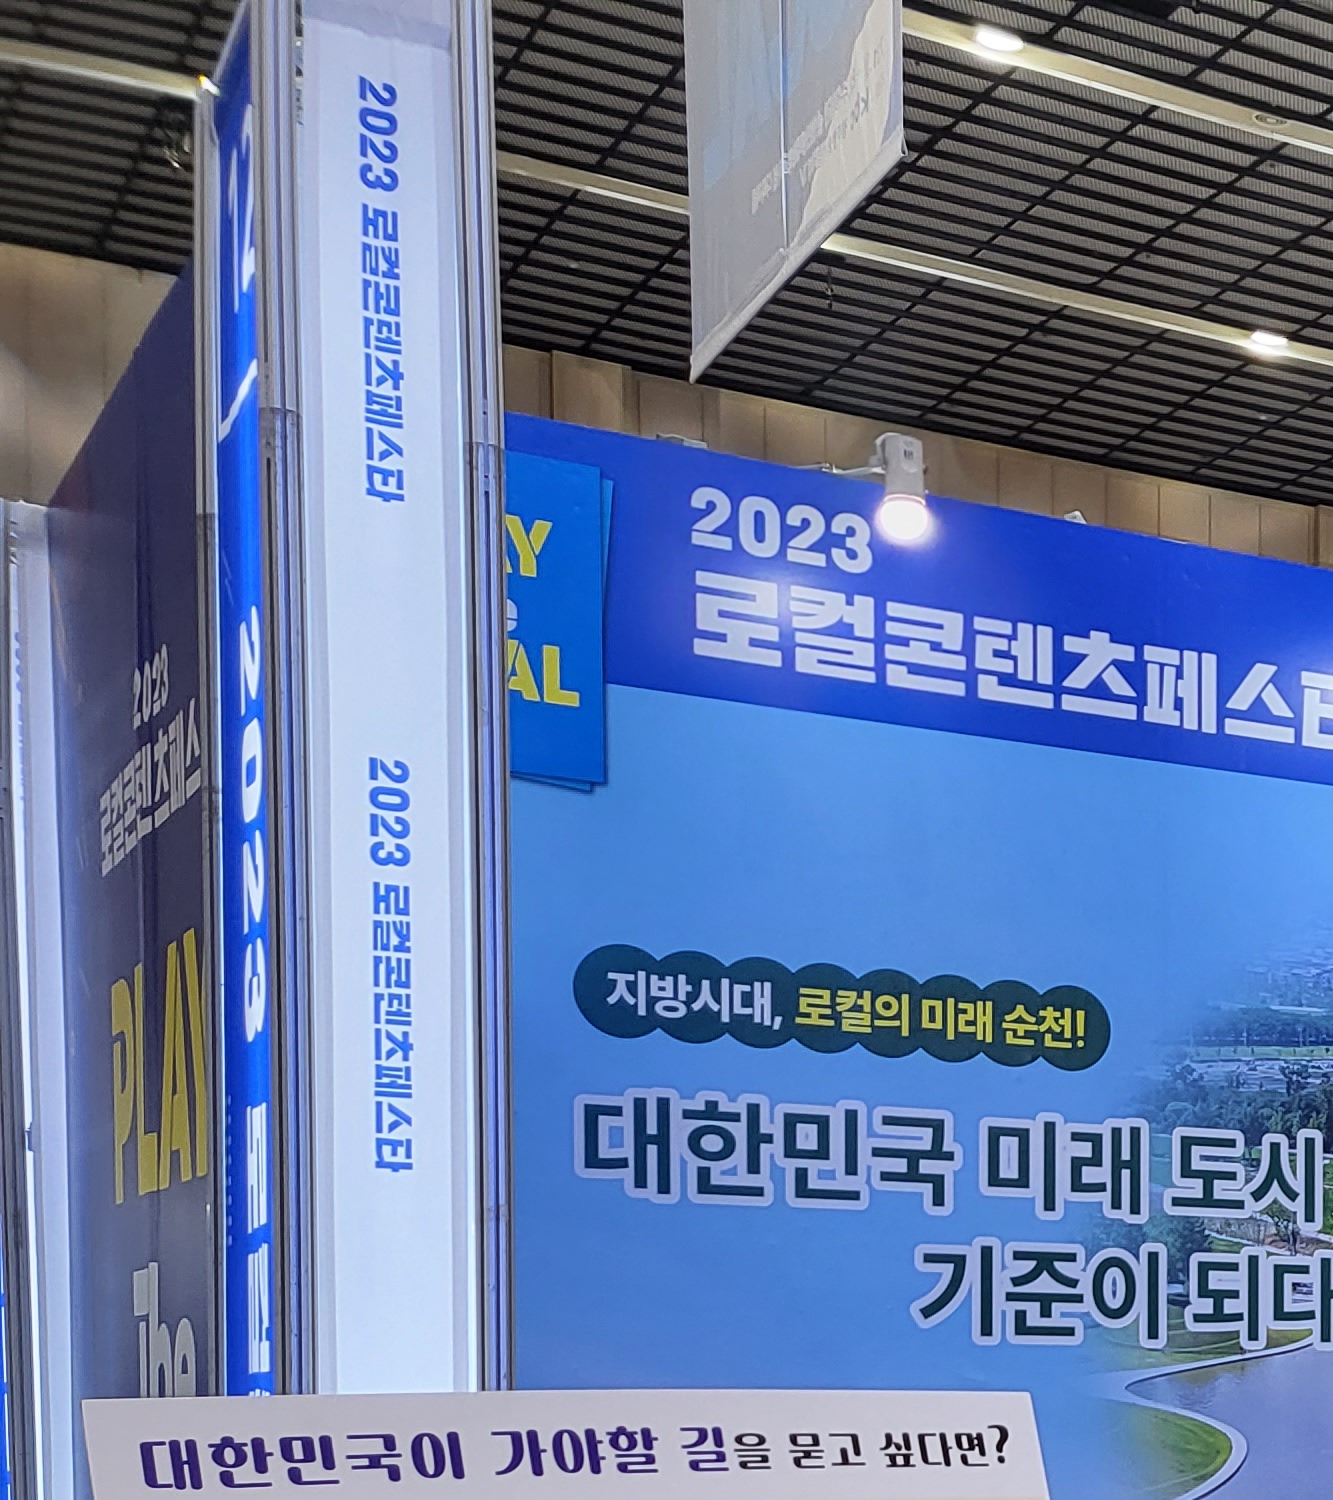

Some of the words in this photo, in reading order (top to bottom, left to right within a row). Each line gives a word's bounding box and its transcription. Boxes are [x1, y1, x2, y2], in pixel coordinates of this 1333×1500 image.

[357, 75, 400, 193] 2023
[360, 203, 407, 503] 로컬콘텐츠페스타
[690, 486, 873, 574] 2023
[133, 643, 169, 731] 2023
[368, 757, 411, 868] 2023
[373, 881, 415, 1173] 로컬콘텐츠페스타
[604, 968, 784, 1033] 지방시대,
[794, 983, 912, 1038] 로컬의
[919, 997, 995, 1045] 미래
[1001, 1003, 1087, 1052] 순천!
[581, 1094, 958, 1211] 대한민국
[984, 1118, 1143, 1219] 미래
[1164, 1130, 1325, 1227] 도시
[916, 1243, 1163, 1344] 기준이
[139, 1429, 465, 1492] 대한민국이
[490, 1424, 660, 1478] 가야할
[679, 1425, 772, 1473] 길을
[788, 1431, 867, 1469] 묻고
[878, 1424, 1010, 1469] 싶다면?
